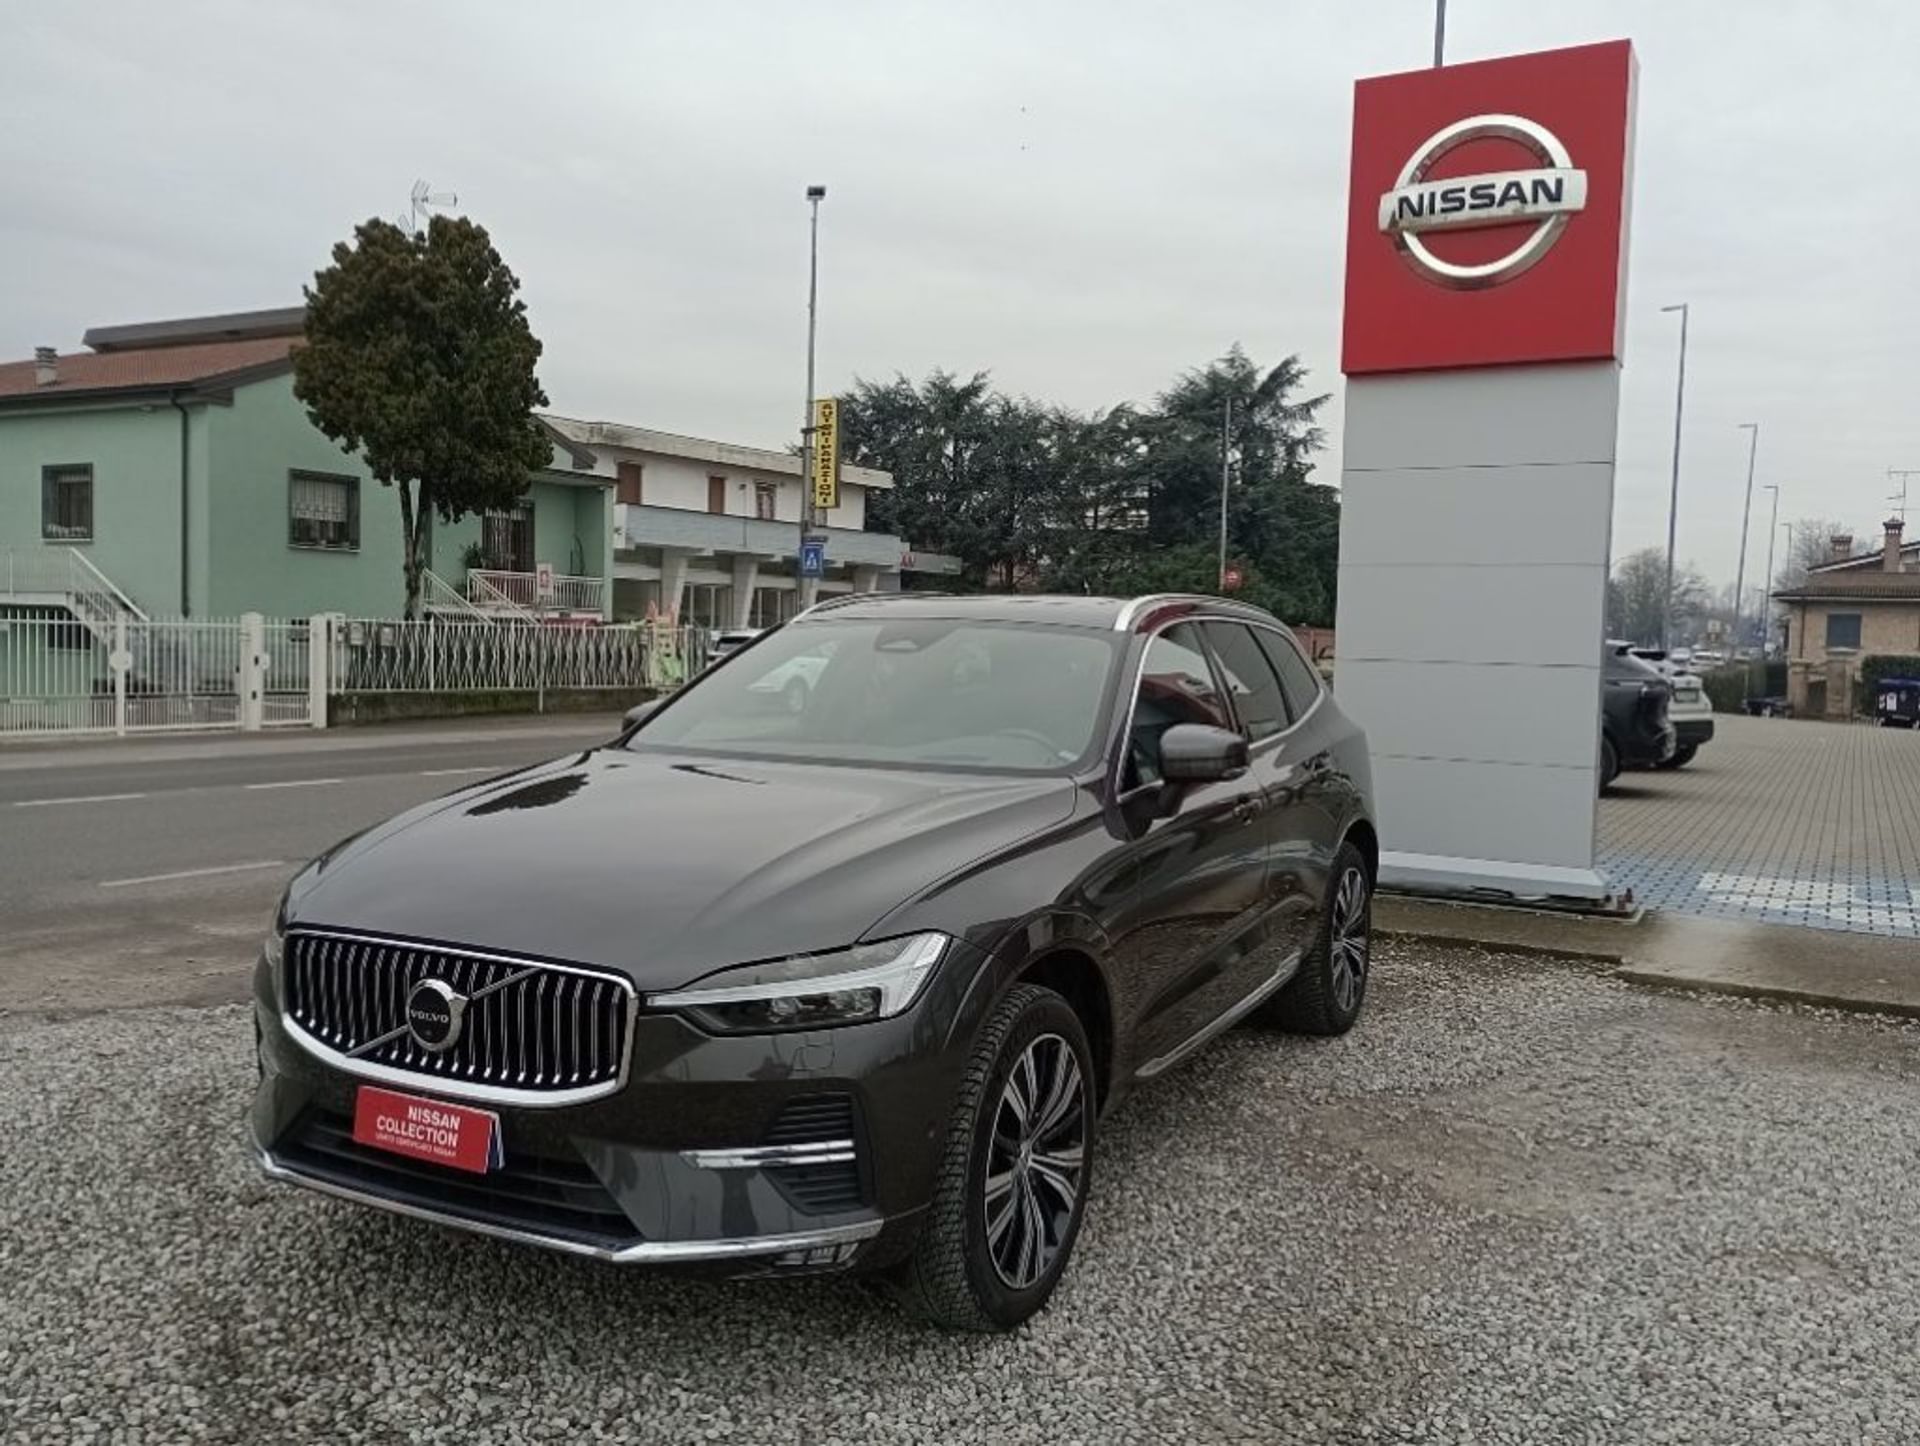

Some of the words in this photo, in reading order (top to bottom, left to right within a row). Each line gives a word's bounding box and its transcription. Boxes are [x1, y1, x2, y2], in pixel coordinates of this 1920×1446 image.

[1398, 178, 1563, 220] NISSAN
[411, 1009, 449, 1023] VOLVO
[376, 1115, 458, 1148] COLLECTION
[408, 1105, 461, 1131] NISSAN
